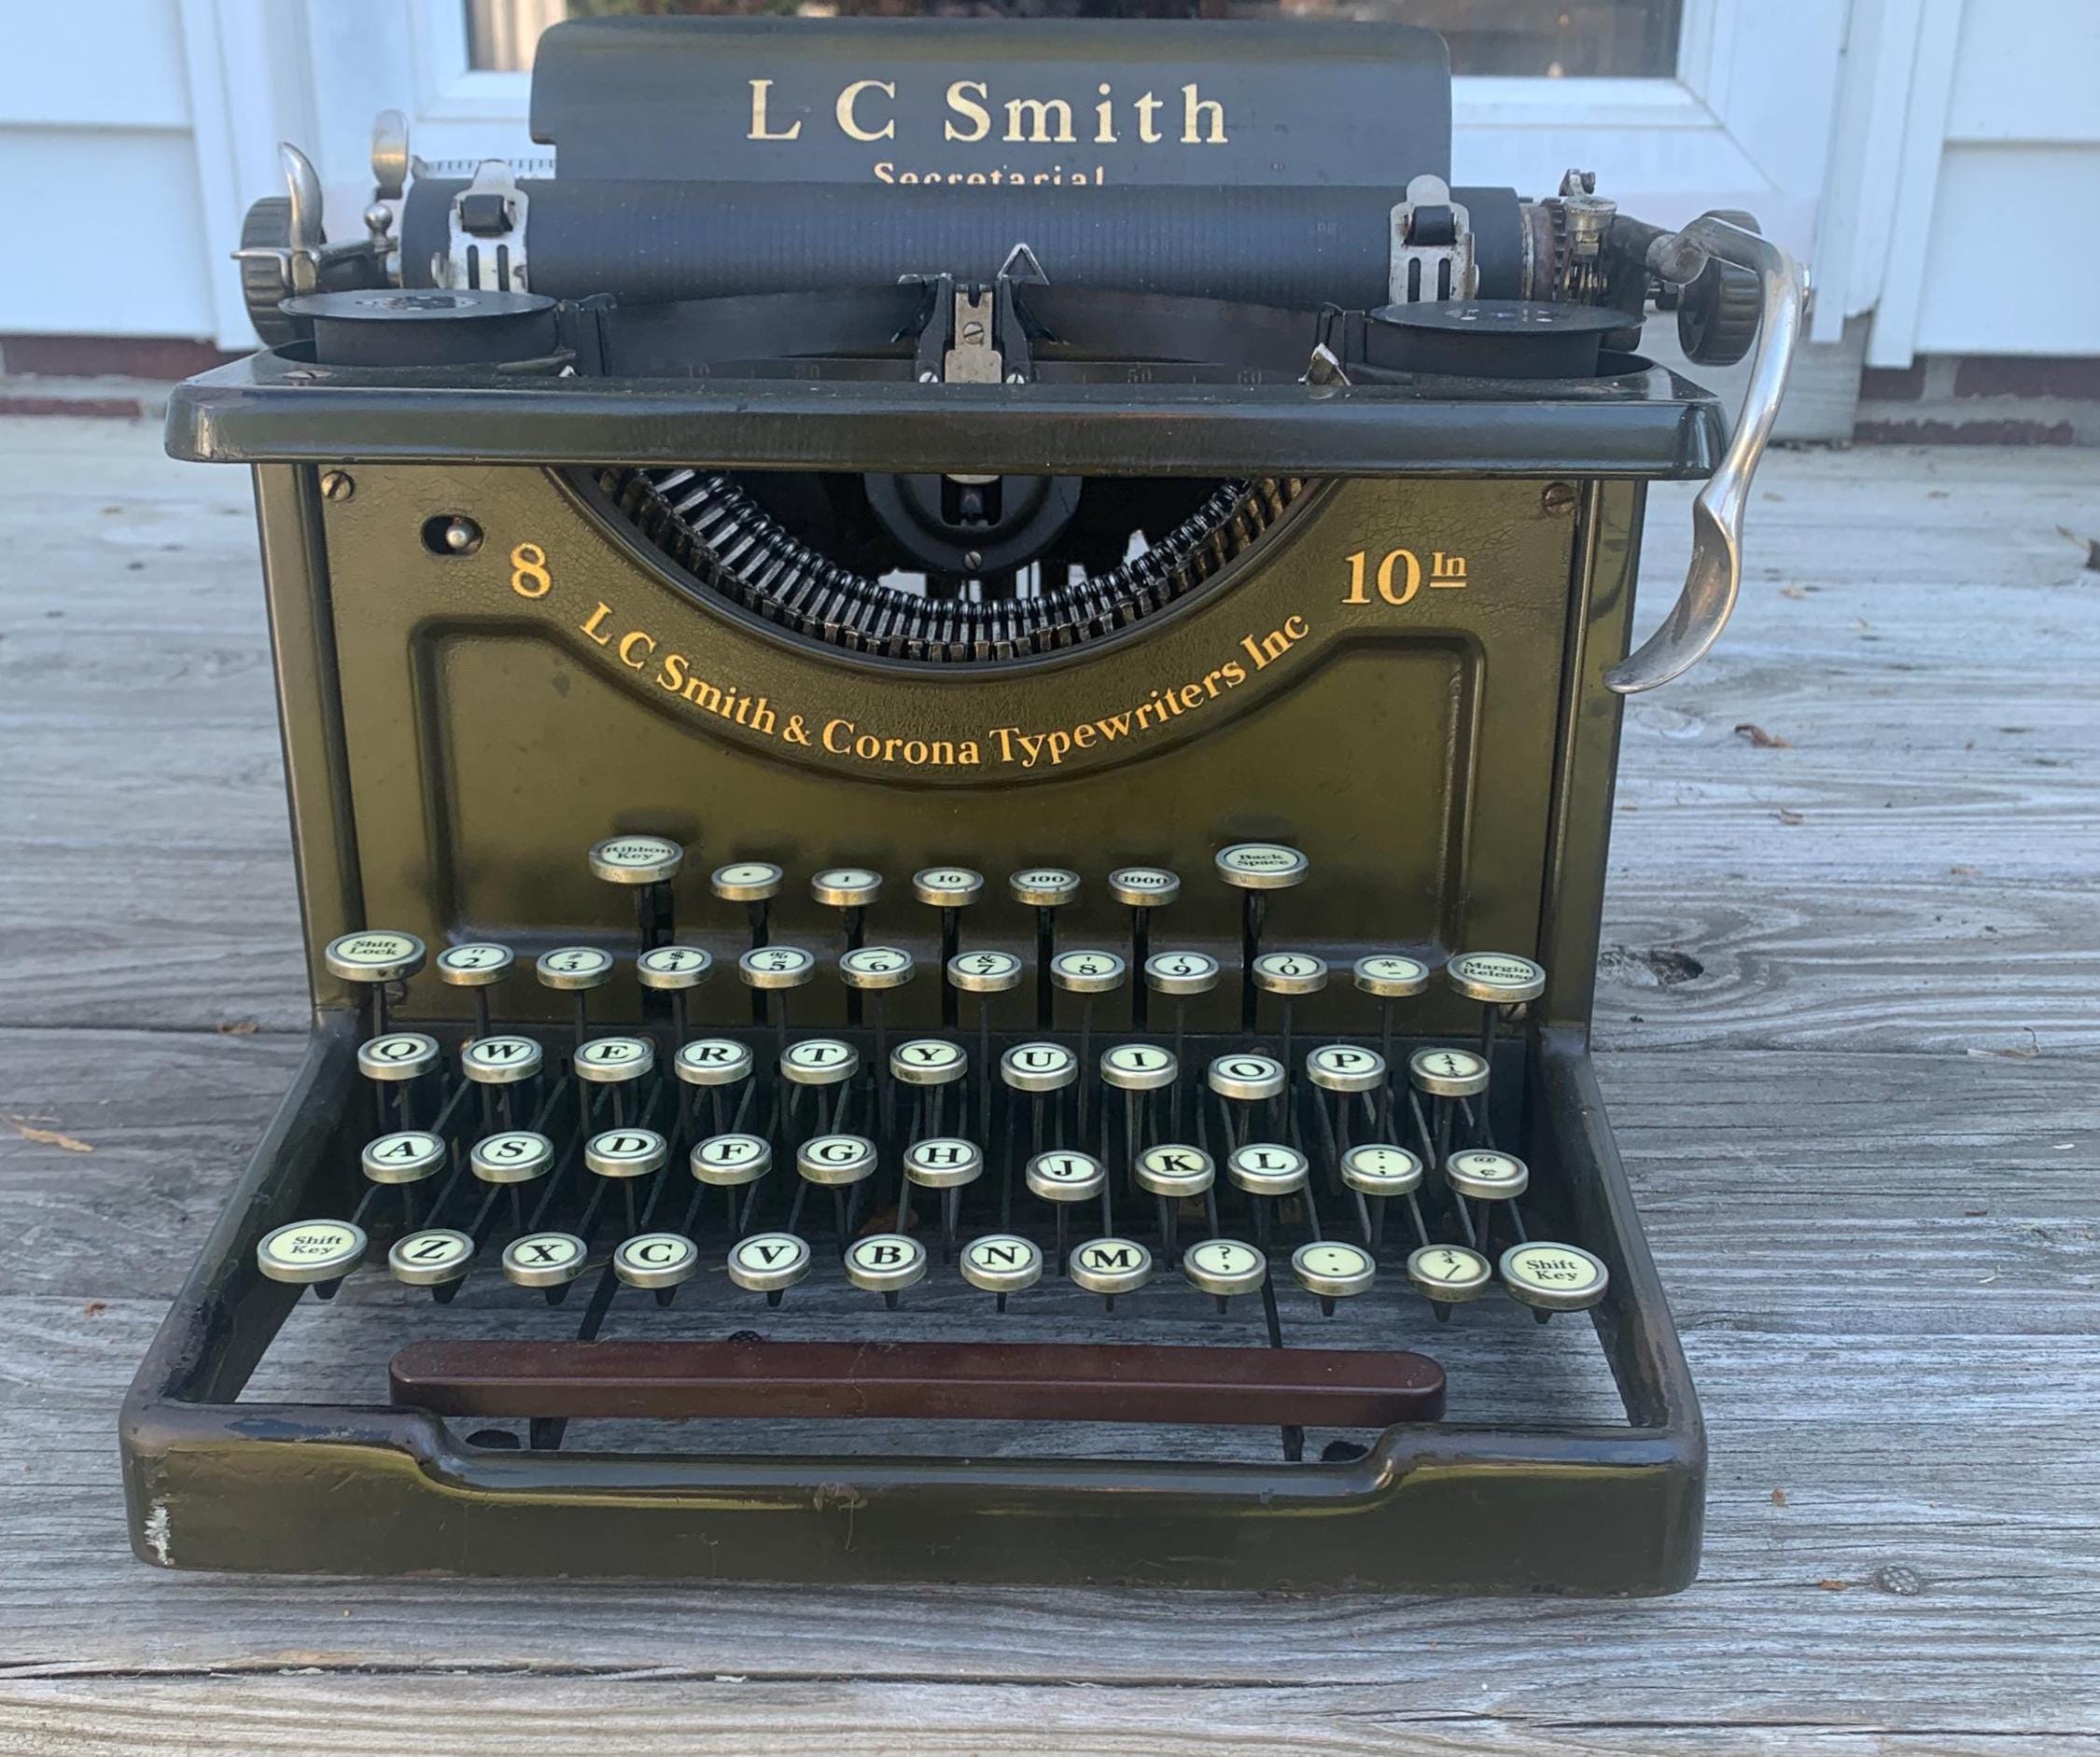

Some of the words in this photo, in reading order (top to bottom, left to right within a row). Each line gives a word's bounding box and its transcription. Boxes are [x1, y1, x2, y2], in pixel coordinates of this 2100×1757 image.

[747, 79, 802, 140] L
[835, 79, 896, 142] C
[945, 80, 1228, 144] Smith
[510, 542, 552, 599] 8
[1341, 549, 1421, 607] 10
[1430, 551, 1467, 580] In
[579, 602, 613, 647] L
[618, 631, 657, 671] C
[655, 653, 776, 735] Smith
[783, 714, 813, 746] &
[821, 719, 981, 766] Corona
[988, 661, 1247, 770] Typewriters
[1240, 613, 1310, 672] Inc
[618, 852, 653, 860] Key
[1029, 875, 1065, 884] 100
[1123, 875, 1169, 885] 1000
[348, 947, 398, 956] Lock
[354, 940, 397, 949] Shift
[462, 957, 480, 968] 2
[560, 961, 578, 970] 3
[661, 961, 680, 970] 4
[769, 961, 786, 971] 5
[869, 961, 889, 971] 6
[976, 964, 994, 974] 7
[1078, 964, 1098, 974] 8
[1173, 965, 1191, 975] 9
[1464, 962, 1530, 973] Margin
[1463, 969, 1533, 980] Release
[381, 1042, 417, 1060] Q
[485, 1044, 525, 1059] W
[596, 1045, 629, 1059] E
[697, 1046, 728, 1061] R
[803, 1048, 837, 1062] T
[911, 1048, 945, 1061] Y
[1027, 1052, 1059, 1067] U
[1130, 1053, 1148, 1067] I
[1333, 1053, 1362, 1067] P
[1230, 1062, 1265, 1077] O
[380, 1141, 419, 1158] A
[496, 1140, 526, 1158] S
[607, 1137, 648, 1152] D
[716, 1143, 749, 1160] F
[820, 1144, 857, 1162] G
[923, 1147, 959, 1164] H
[1255, 1152, 1286, 1169] L
[1054, 1160, 1075, 1176] J
[1158, 1155, 1198, 1172] K
[294, 1235, 343, 1246] Shift
[290, 1245, 335, 1256] Key
[411, 1239, 453, 1260] Z
[525, 1245, 563, 1262] X
[639, 1243, 673, 1262] C
[755, 1246, 791, 1264] V
[872, 1246, 902, 1264] B
[983, 1246, 1019, 1264] N
[1090, 1248, 1132, 1268] M
[1526, 1260, 1578, 1270] Shift
[1536, 1269, 1577, 1281] Key
